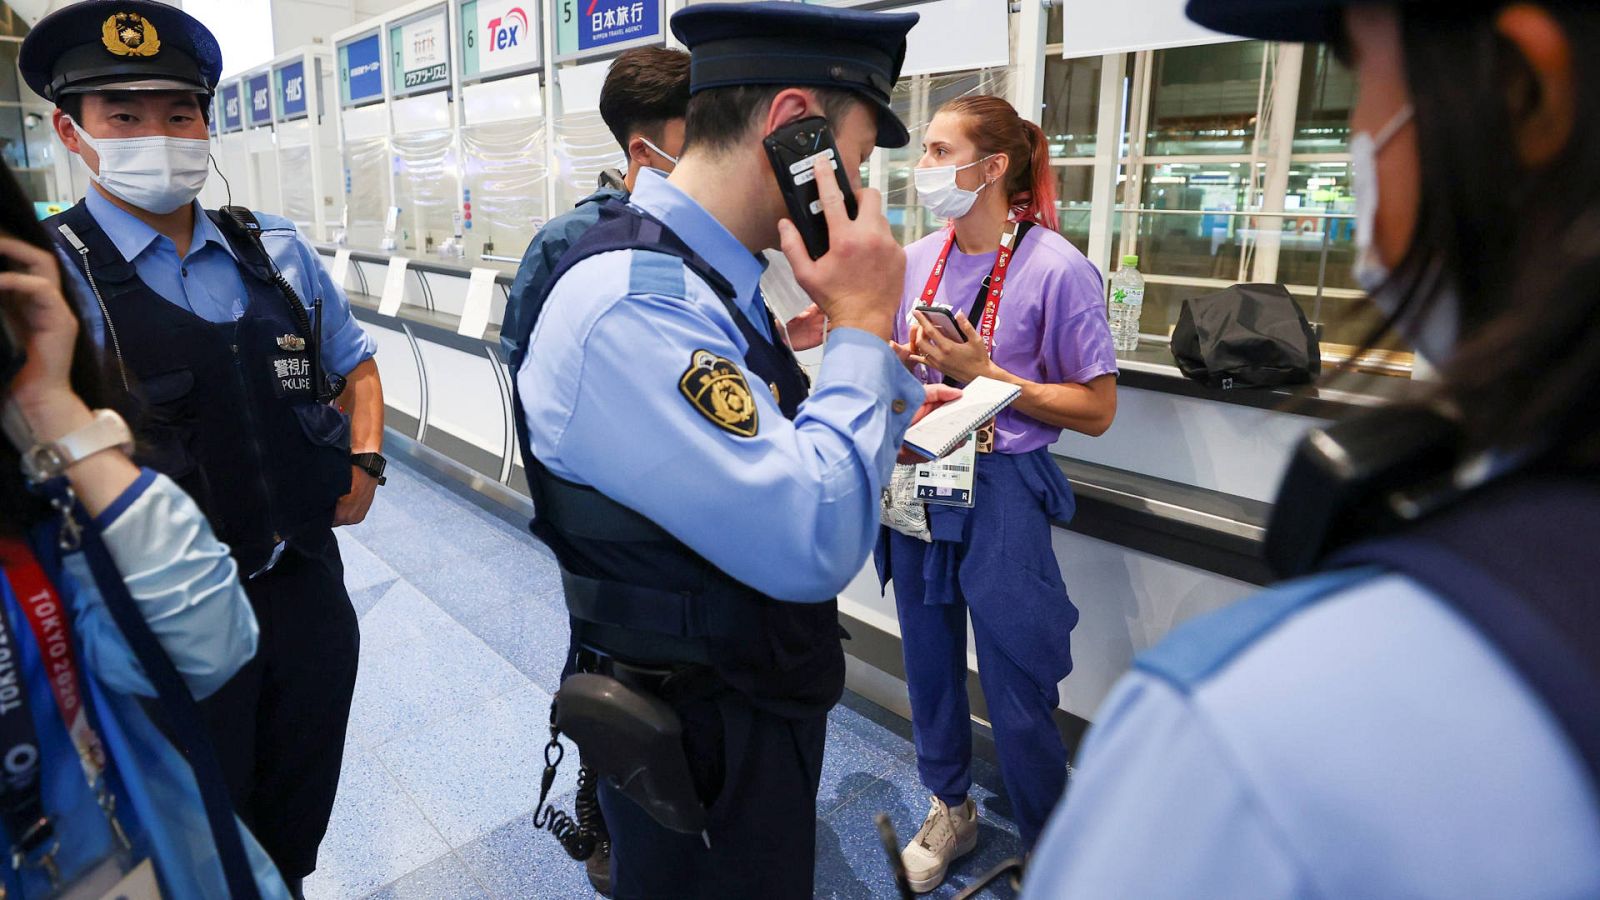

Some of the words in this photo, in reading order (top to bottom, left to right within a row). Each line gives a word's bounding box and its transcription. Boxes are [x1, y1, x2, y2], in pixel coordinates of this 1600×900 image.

[563, 1, 571, 23] 5
[592, 2, 643, 32] 日本旅行
[467, 30, 474, 48] 6
[487, 17, 518, 52] Tex
[592, 32, 608, 40] NIPPON
[608, 28, 624, 37] TRAVEL
[625, 25, 642, 33] AGENCY
[286, 76, 302, 102] HIS
[273, 358, 311, 378] 警視庁
[282, 378, 311, 390] POLICE
[928, 489, 934, 497] 2
[962, 492, 968, 500] R
[29, 588, 67, 658] TOKYO
[53, 658, 77, 709] 2020
